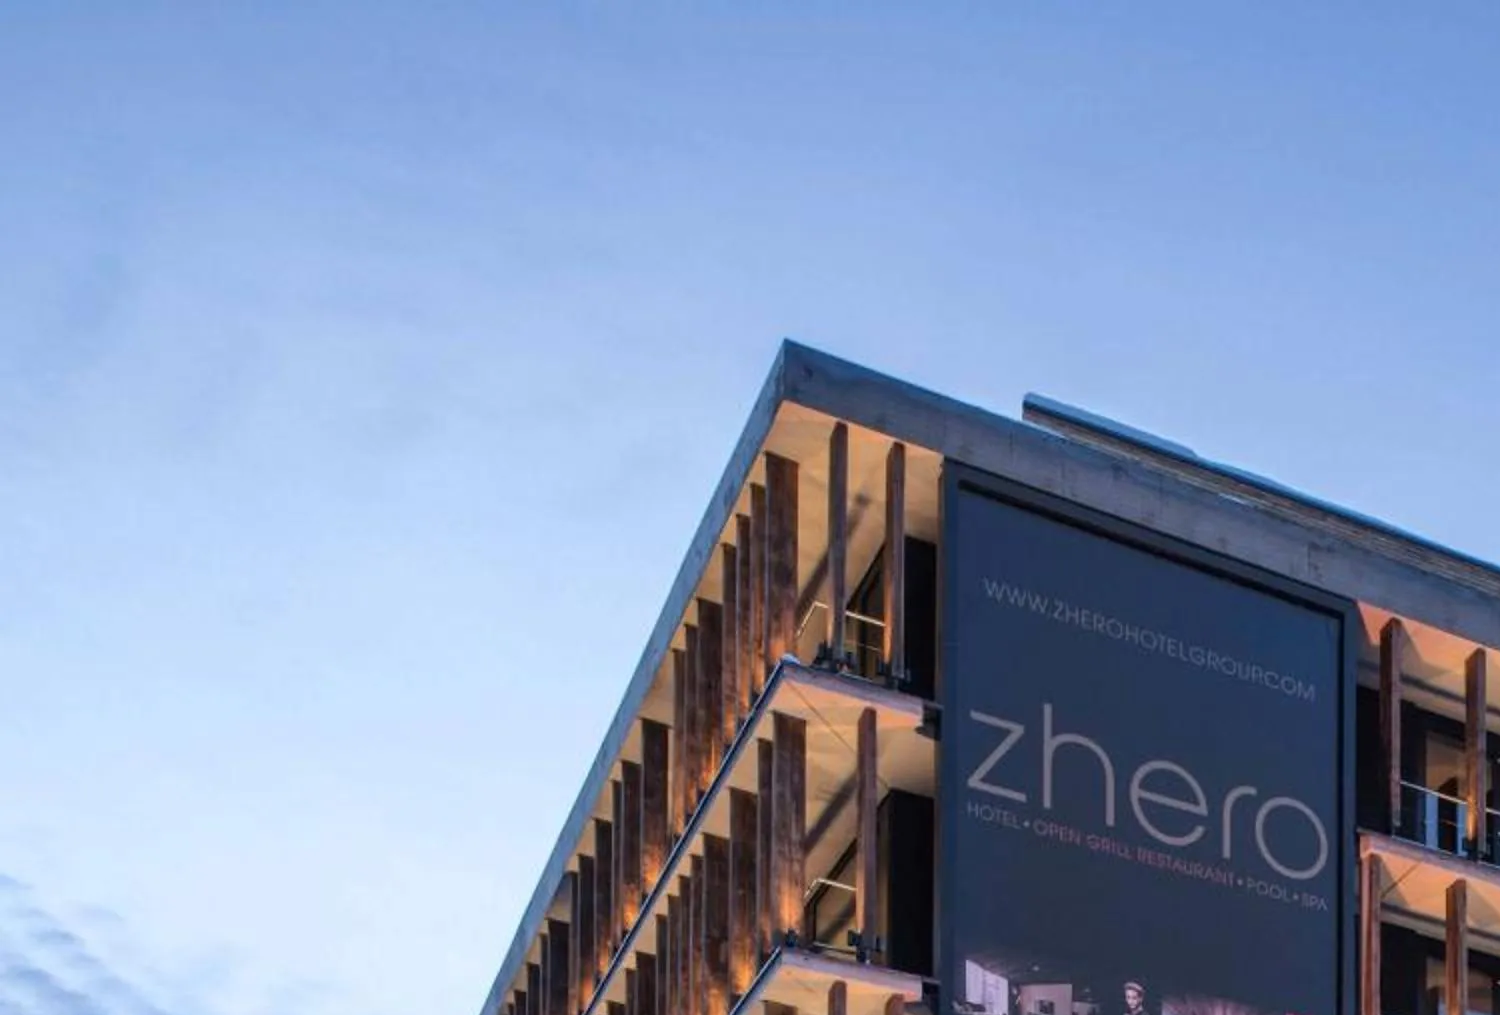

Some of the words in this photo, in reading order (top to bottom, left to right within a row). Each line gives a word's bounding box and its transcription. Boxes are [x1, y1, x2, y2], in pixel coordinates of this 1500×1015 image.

[966, 703, 1329, 880] zhero
[967, 800, 1022, 829] HOTEL
[1032, 818, 1081, 846] OPEN
[1086, 834, 1132, 860] GRILL
[1136, 847, 1235, 888] RESTAURANT
[1246, 876, 1292, 903] POOL
[1300, 892, 1328, 911] SPA
